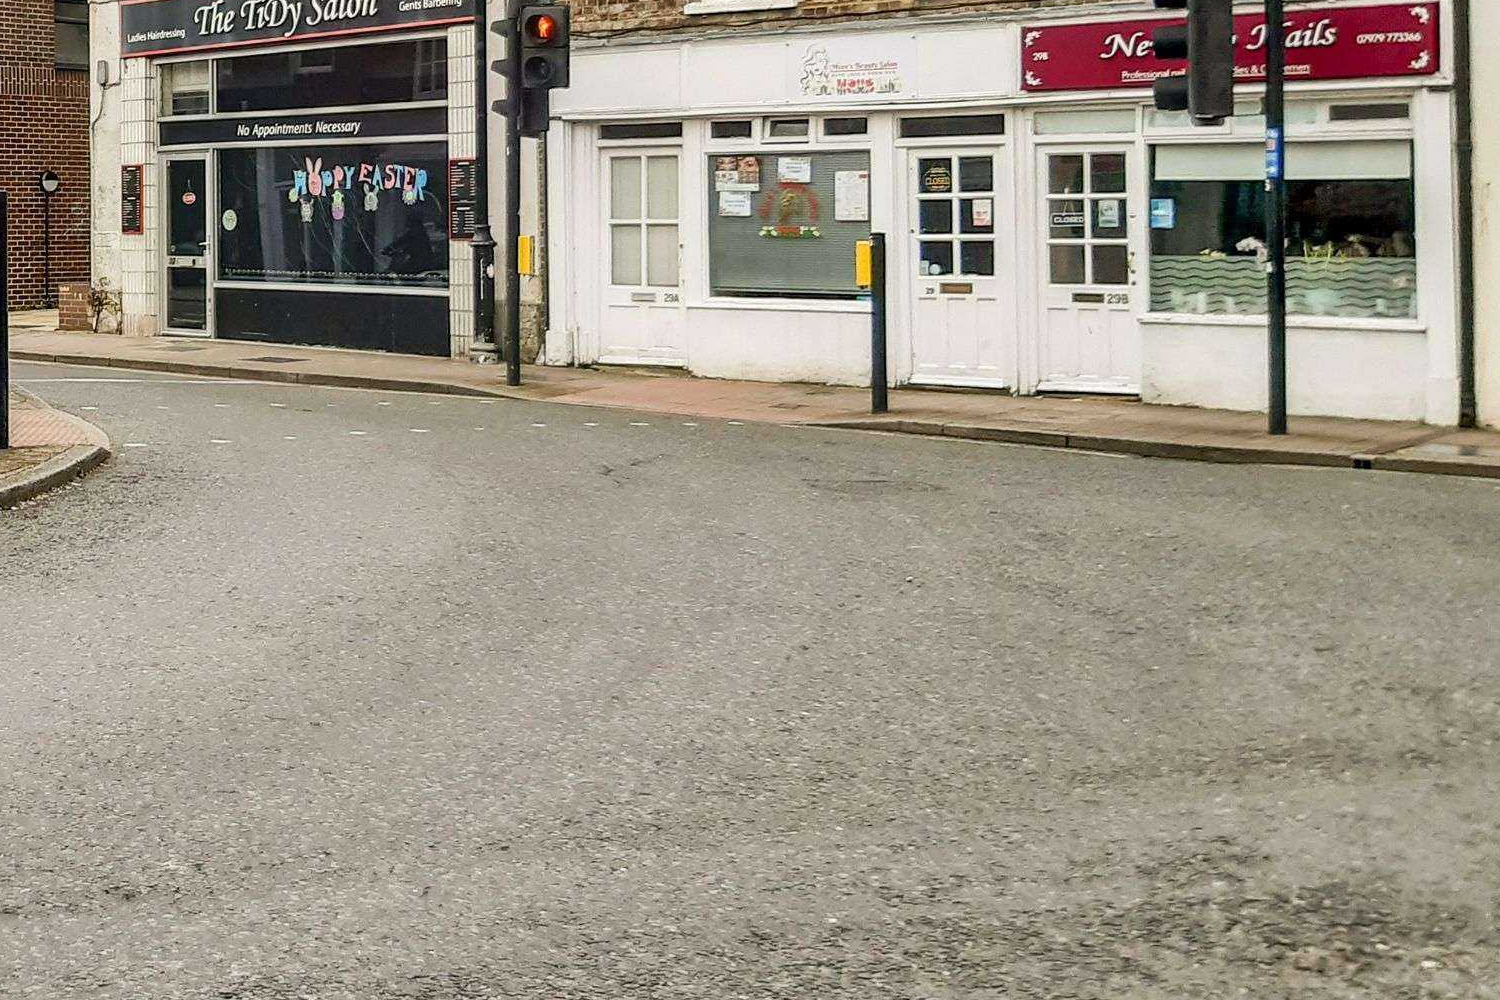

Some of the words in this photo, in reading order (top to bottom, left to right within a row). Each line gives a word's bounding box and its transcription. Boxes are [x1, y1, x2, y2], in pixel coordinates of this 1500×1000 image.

[398, 0, 421, 12] Gents
[194, 0, 235, 36] The
[127, 32, 147, 43] Ladies
[147, 29, 185, 42] Hairdressing
[1121, 69, 1169, 79] Professional
[237, 124, 250, 136] No
[252, 123, 312, 138] Appointments
[315, 121, 361, 135] Necessary
[358, 163, 428, 201] EASTER
